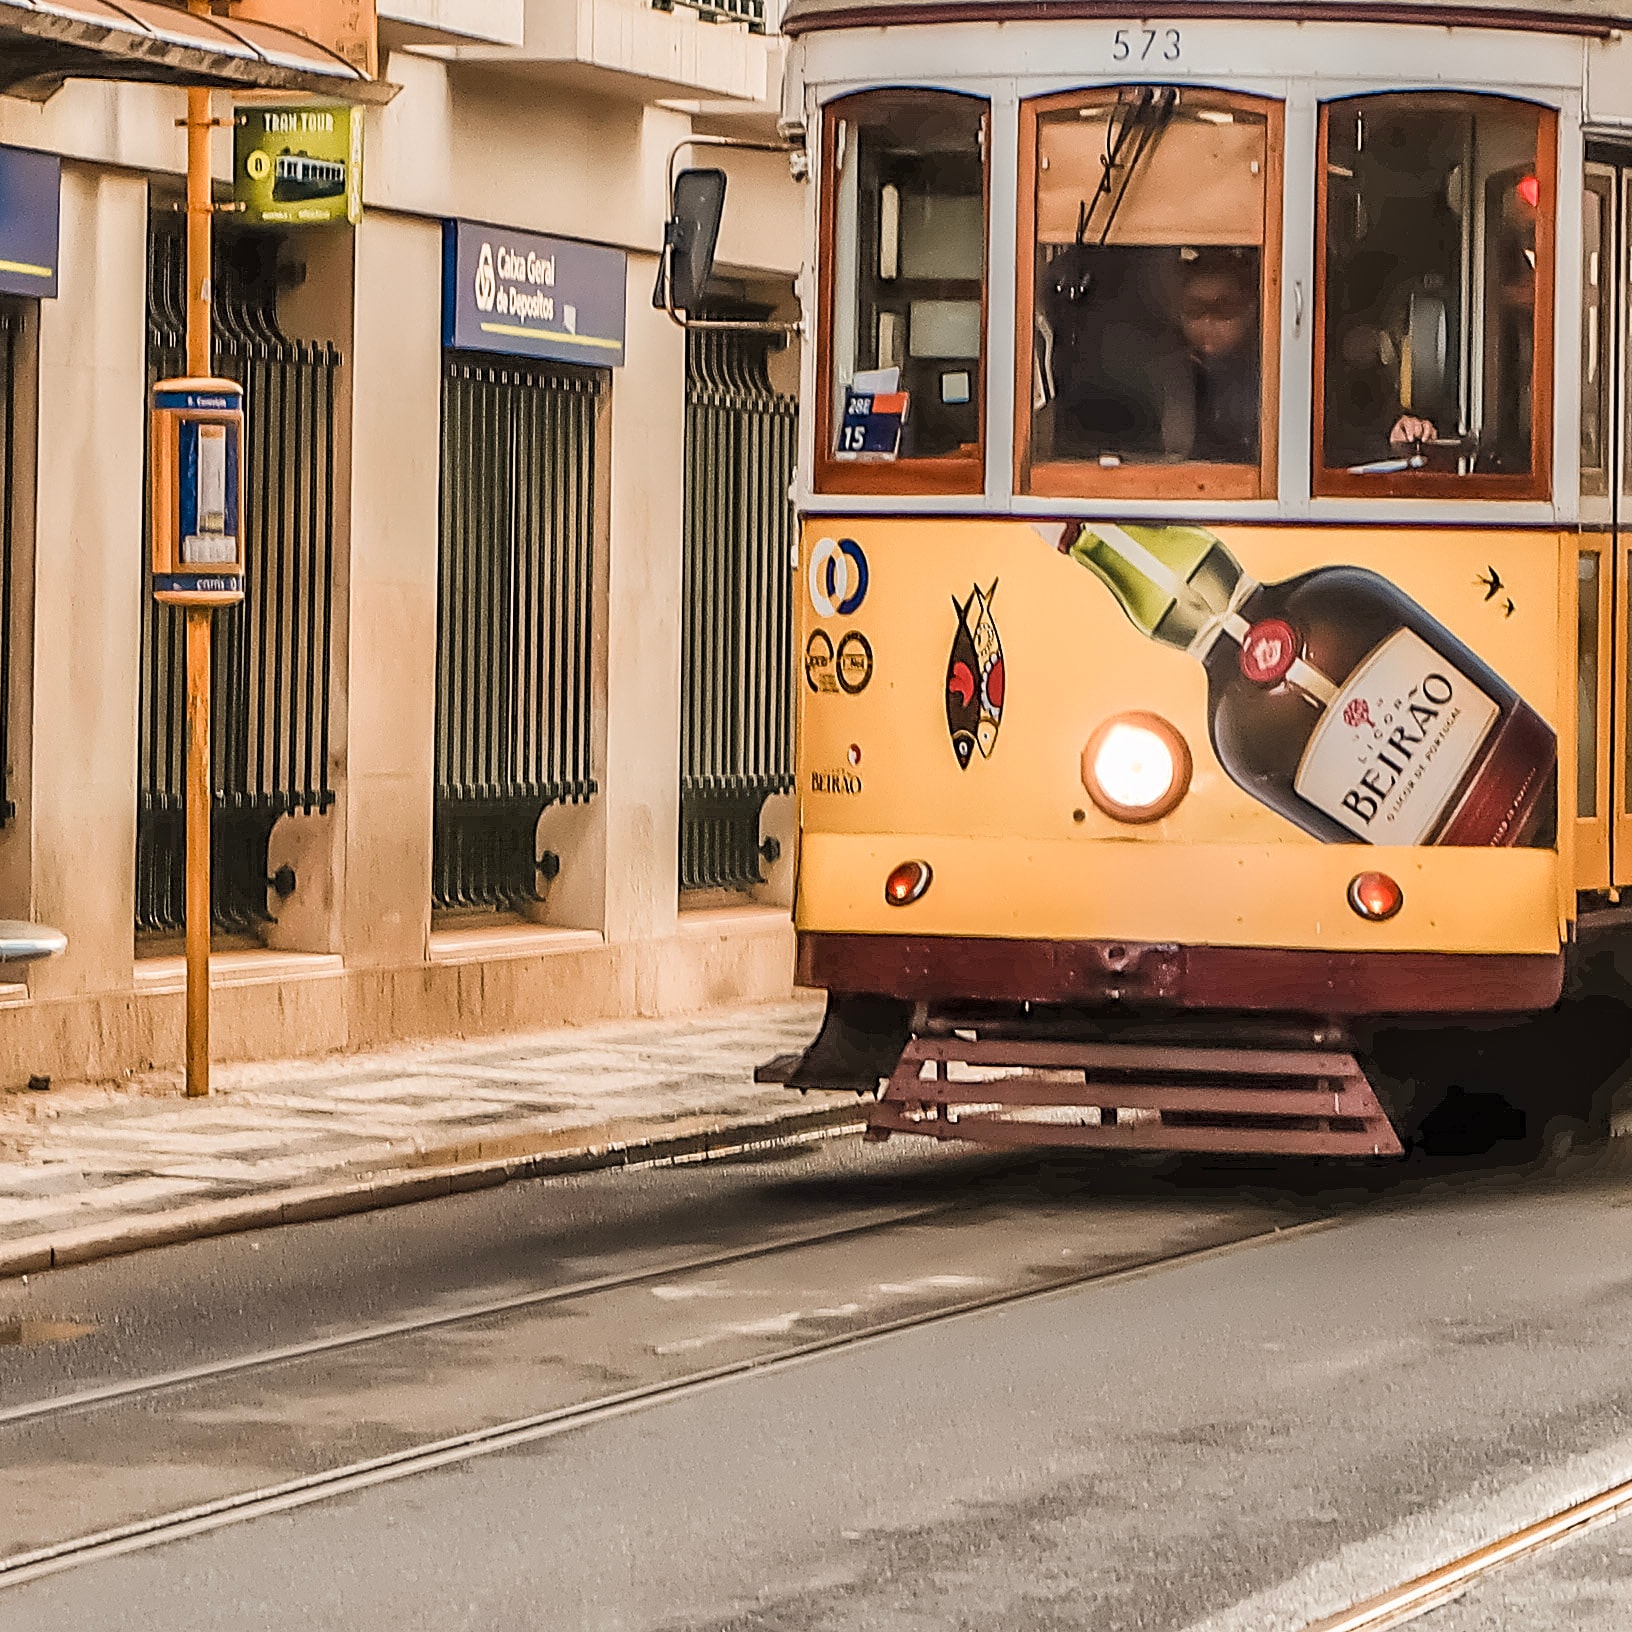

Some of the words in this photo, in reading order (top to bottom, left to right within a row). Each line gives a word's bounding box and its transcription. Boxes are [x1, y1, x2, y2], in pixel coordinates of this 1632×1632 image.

[1112, 28, 1181, 61] 573
[264, 112, 297, 133] TRAM
[300, 112, 334, 133] TOUR
[496, 245, 526, 283] Caixa
[527, 251, 556, 287] Geral
[496, 285, 509, 314] de
[844, 425, 866, 450] 15
[1341, 673, 1453, 825] BEIRÃO
